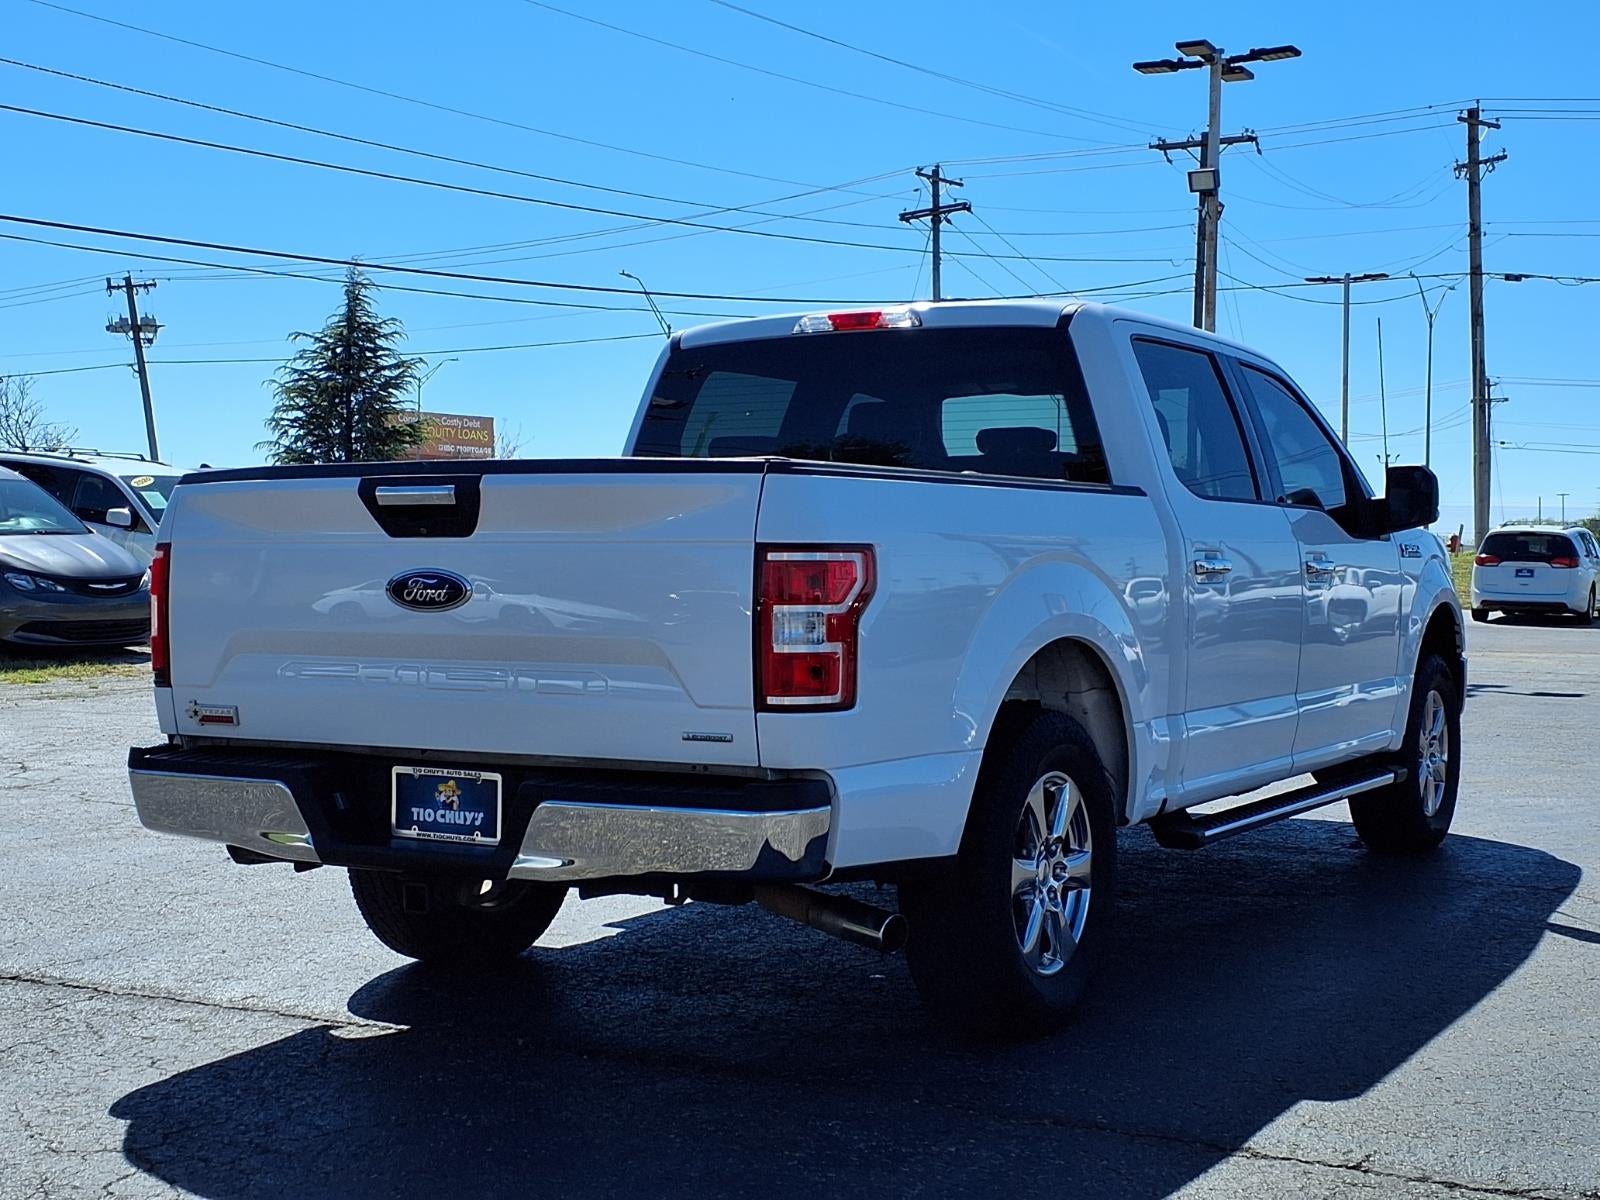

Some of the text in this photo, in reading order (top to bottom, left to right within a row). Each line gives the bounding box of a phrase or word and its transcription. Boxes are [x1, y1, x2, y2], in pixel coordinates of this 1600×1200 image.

[441, 416, 462, 428] Costly
[463, 418, 480, 428] Debt
[458, 428, 489, 441] LOANS
[403, 577, 449, 602] Ford
[411, 807, 484, 825] TIO CHUY'S
